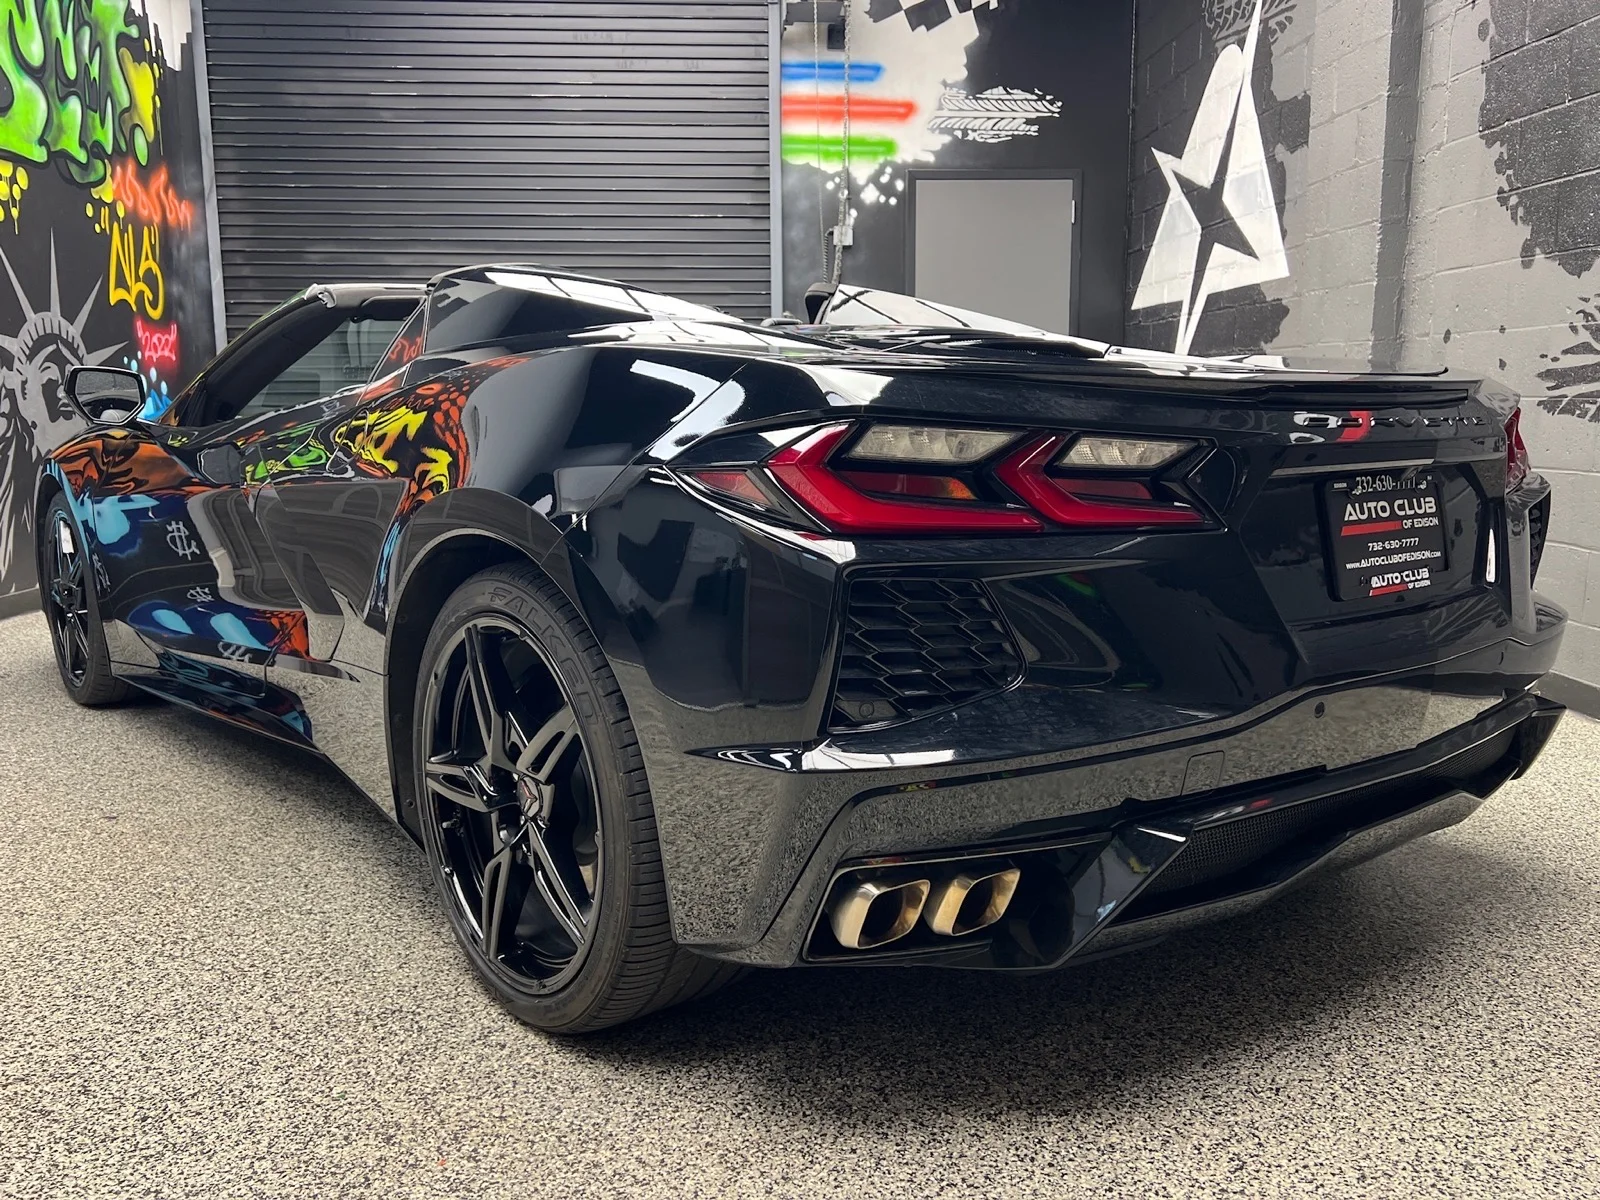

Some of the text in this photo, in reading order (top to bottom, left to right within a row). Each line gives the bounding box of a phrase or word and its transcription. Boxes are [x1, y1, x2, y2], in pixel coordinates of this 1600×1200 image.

[1344, 496, 1437, 521] AUTO CLUB
[1402, 516, 1439, 529] OF EDISON
[1368, 537, 1420, 552] 732-630-7777
[1371, 567, 1430, 588] AUTO CLUB
